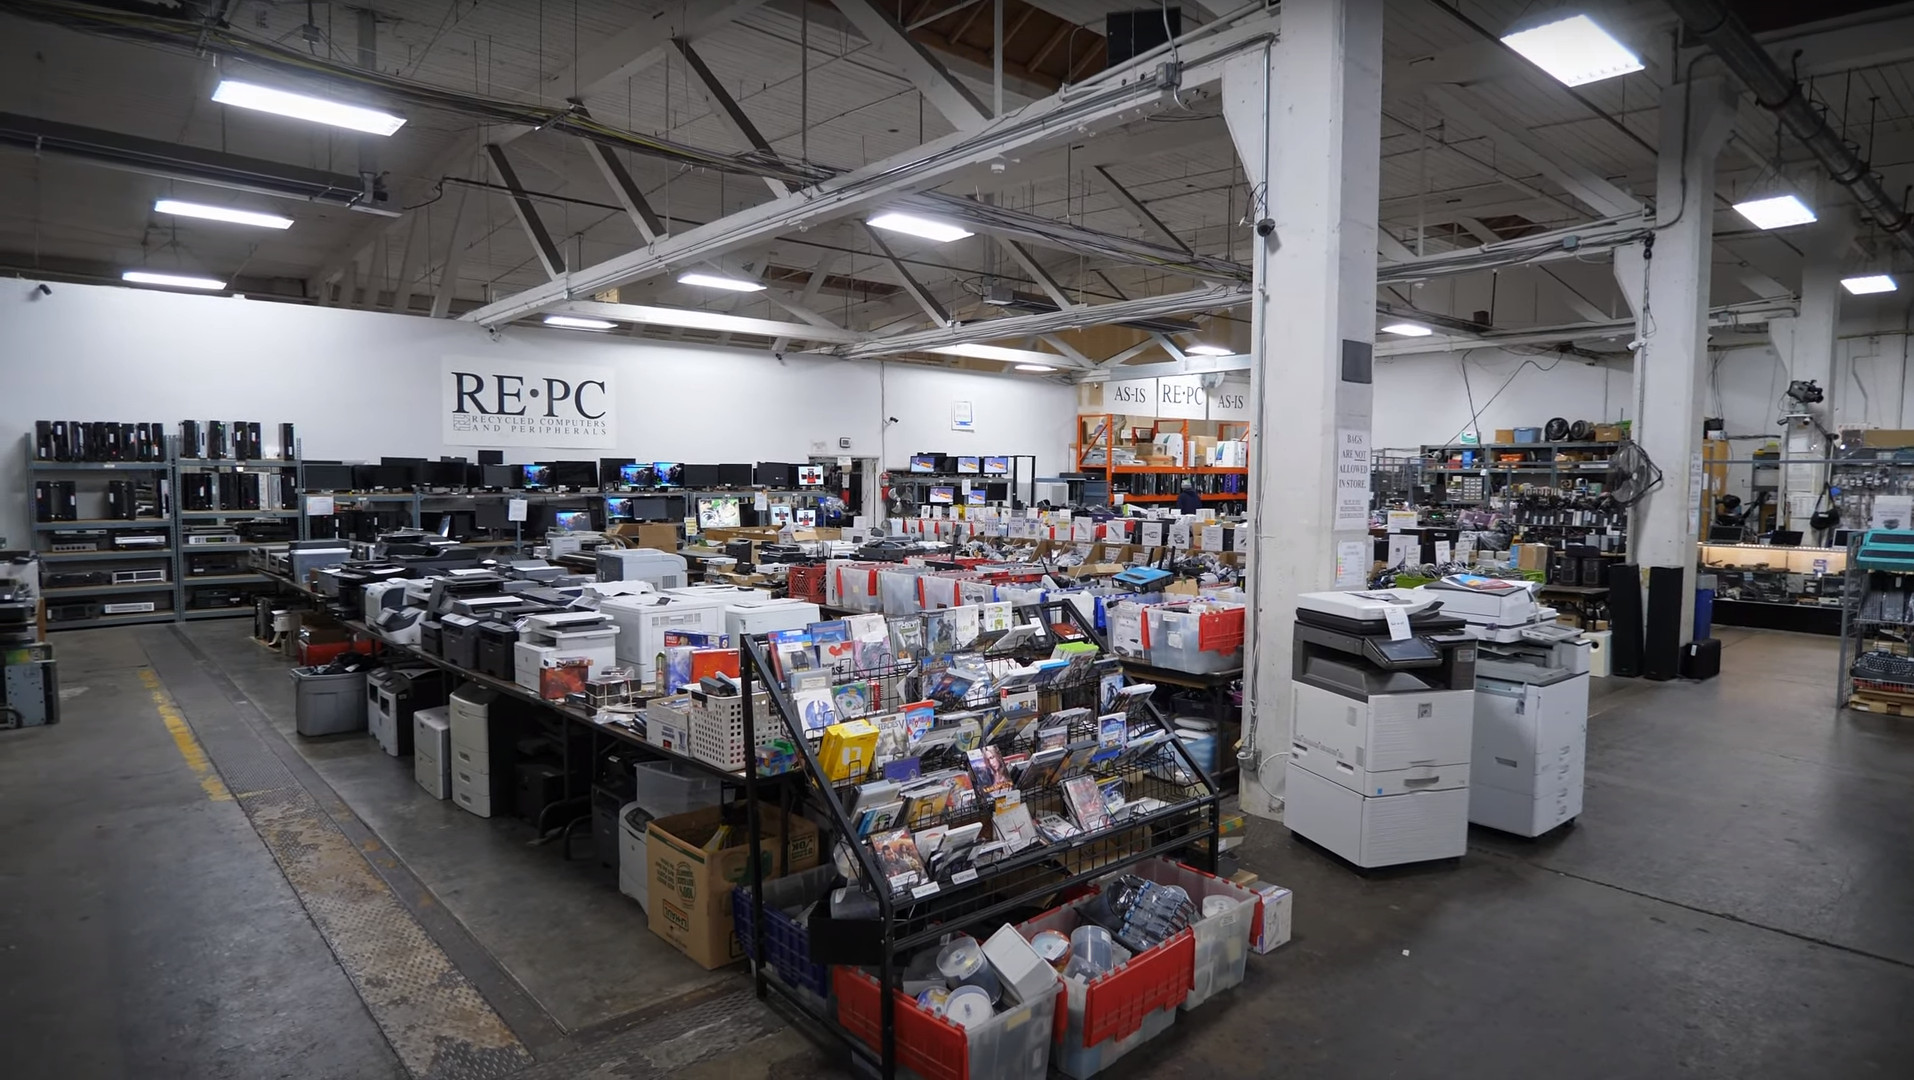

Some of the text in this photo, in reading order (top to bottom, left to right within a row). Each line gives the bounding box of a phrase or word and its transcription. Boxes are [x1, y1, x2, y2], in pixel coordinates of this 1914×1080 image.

[1114, 386, 1146, 403] AS-IS
[1218, 395, 1243, 409] AS-IS
[472, 415, 606, 427] RECYCLED COMPUTERS
[472, 424, 606, 435] AND PERIPHERALS
[1347, 434, 1362, 444] BAGS
[1342, 450, 1366, 459] ARE NOT
[1340, 464, 1368, 473] ALLOWED
[1339, 479, 1366, 488] IN STORE.
